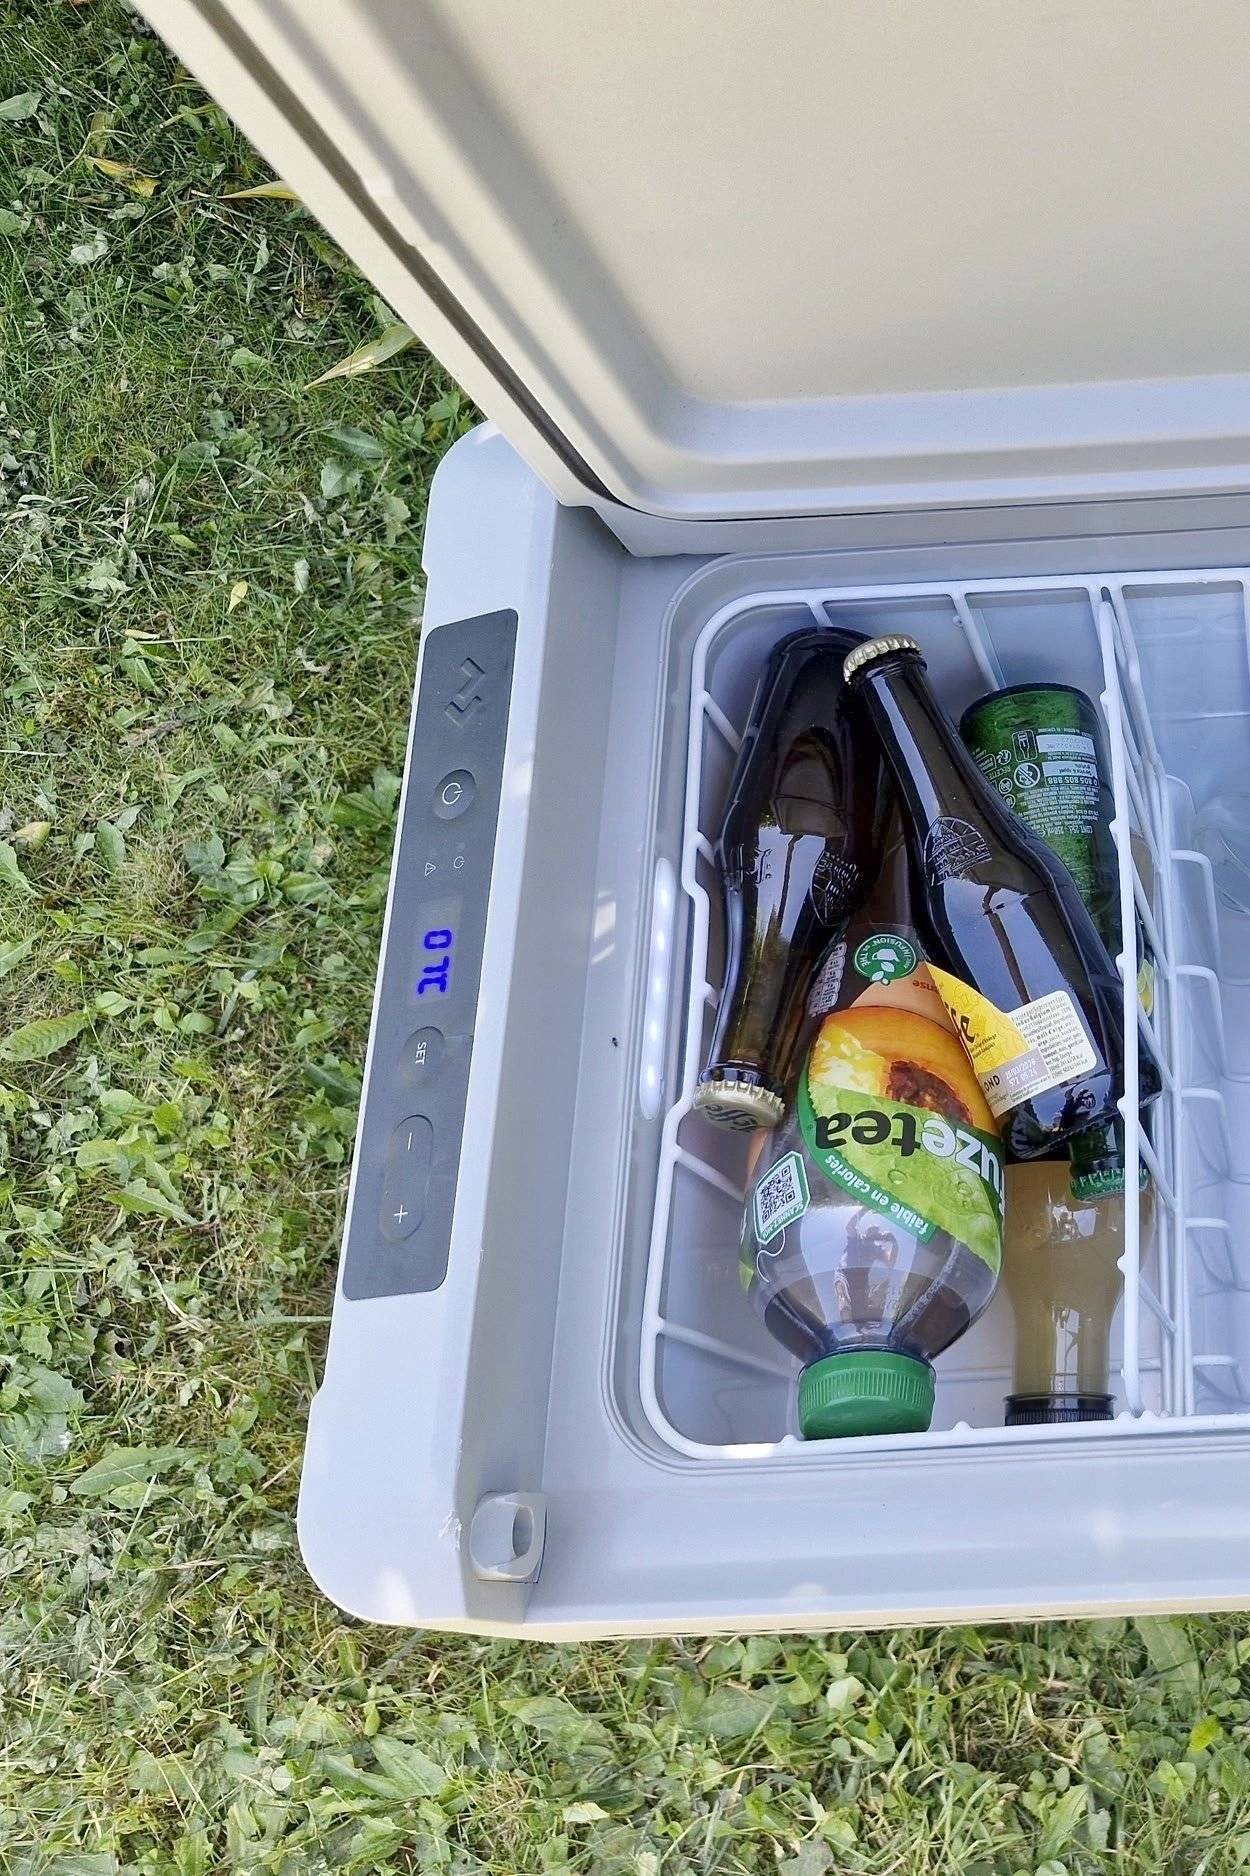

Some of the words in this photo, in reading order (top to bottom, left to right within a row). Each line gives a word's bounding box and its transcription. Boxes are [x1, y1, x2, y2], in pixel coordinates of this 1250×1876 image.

[1048, 776, 1063, 784] 888
[872, 938, 911, 956] INFUSION
[414, 1041, 428, 1065] SET
[981, 1074, 1001, 1093] OND
[825, 1154, 871, 1196] calories
[871, 1190, 889, 1205] en
[889, 1201, 928, 1234] faible
